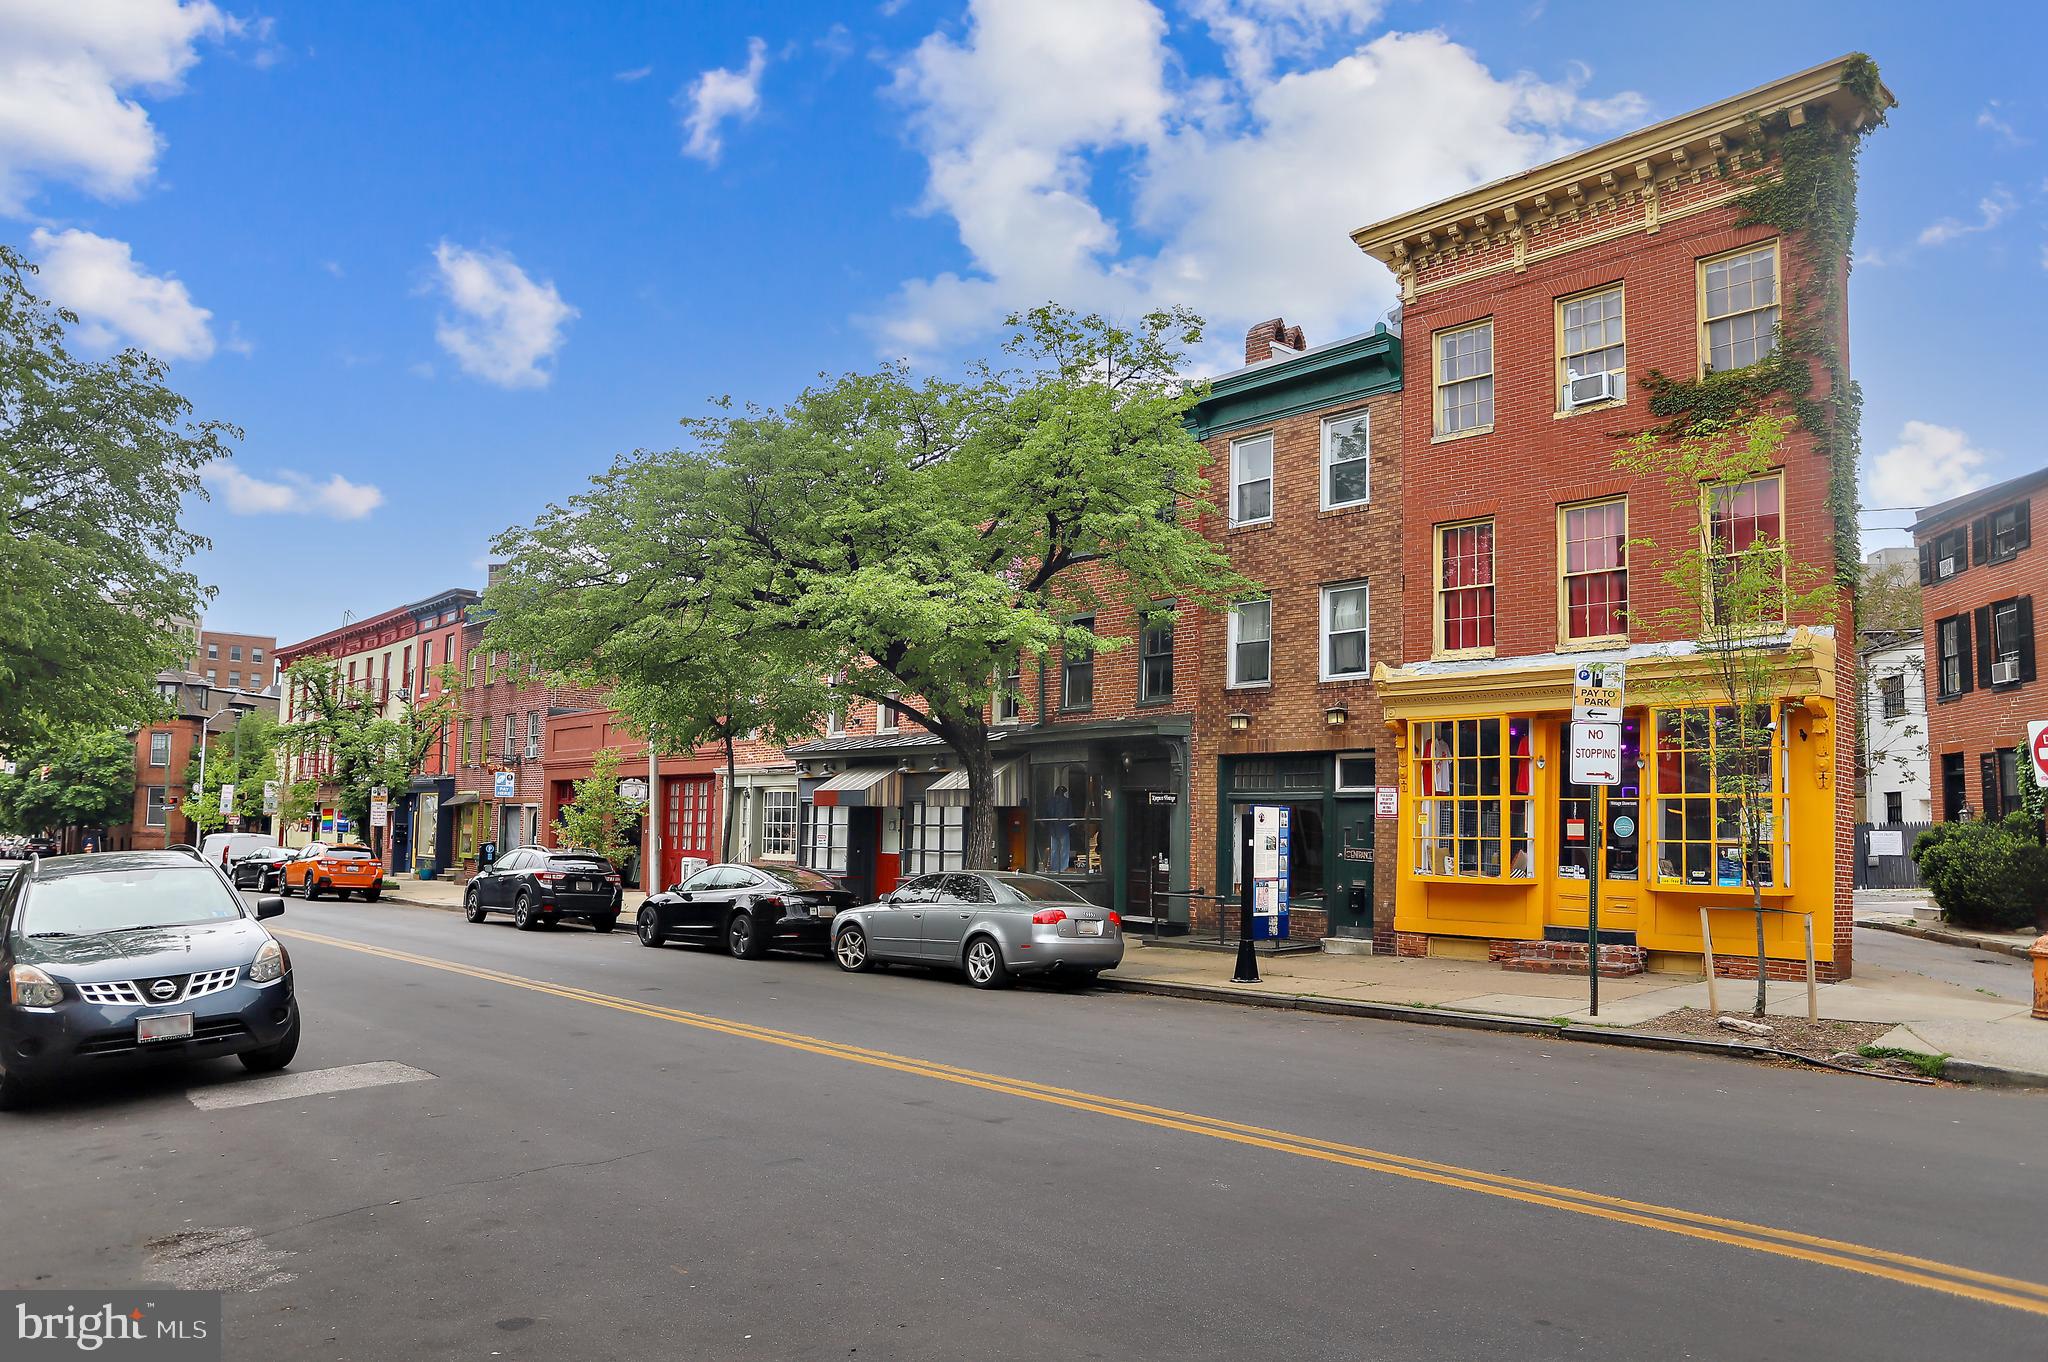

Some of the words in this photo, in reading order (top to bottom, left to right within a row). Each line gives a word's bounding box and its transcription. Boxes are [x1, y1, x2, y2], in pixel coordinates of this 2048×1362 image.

[1581, 689, 1599, 697] PAY
[1602, 690, 1616, 698] TO
[1584, 698, 1611, 707] PARK
[1588, 729, 1604, 740] NO
[1575, 748, 1617, 759] STOPPING
